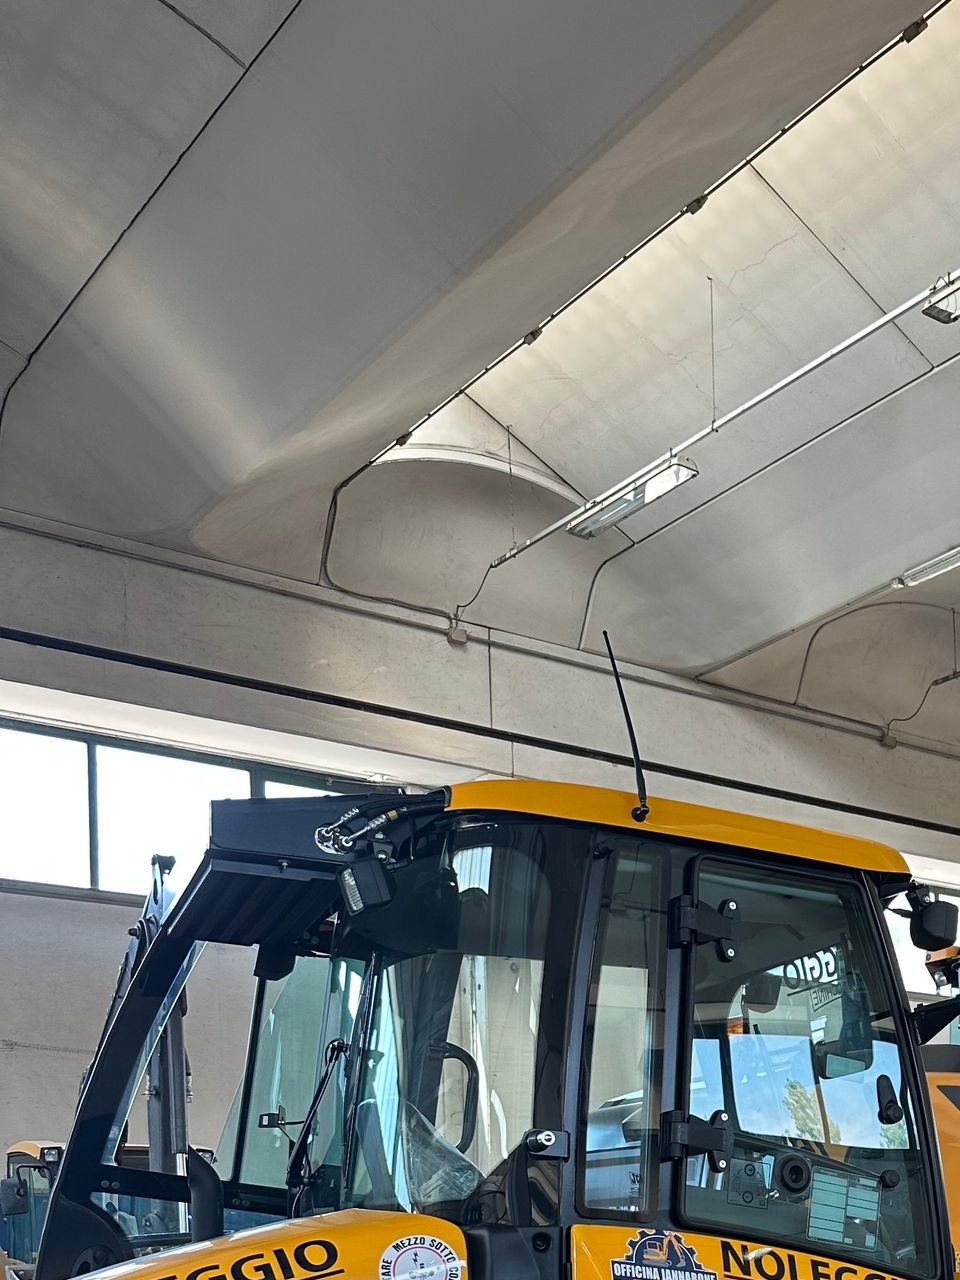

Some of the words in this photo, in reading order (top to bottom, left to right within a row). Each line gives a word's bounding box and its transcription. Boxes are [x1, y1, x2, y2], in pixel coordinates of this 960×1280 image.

[392, 1236, 425, 1253] MEZZO
[429, 1239, 456, 1264] SOTTO
[613, 1263, 660, 1280] OFFICINA
